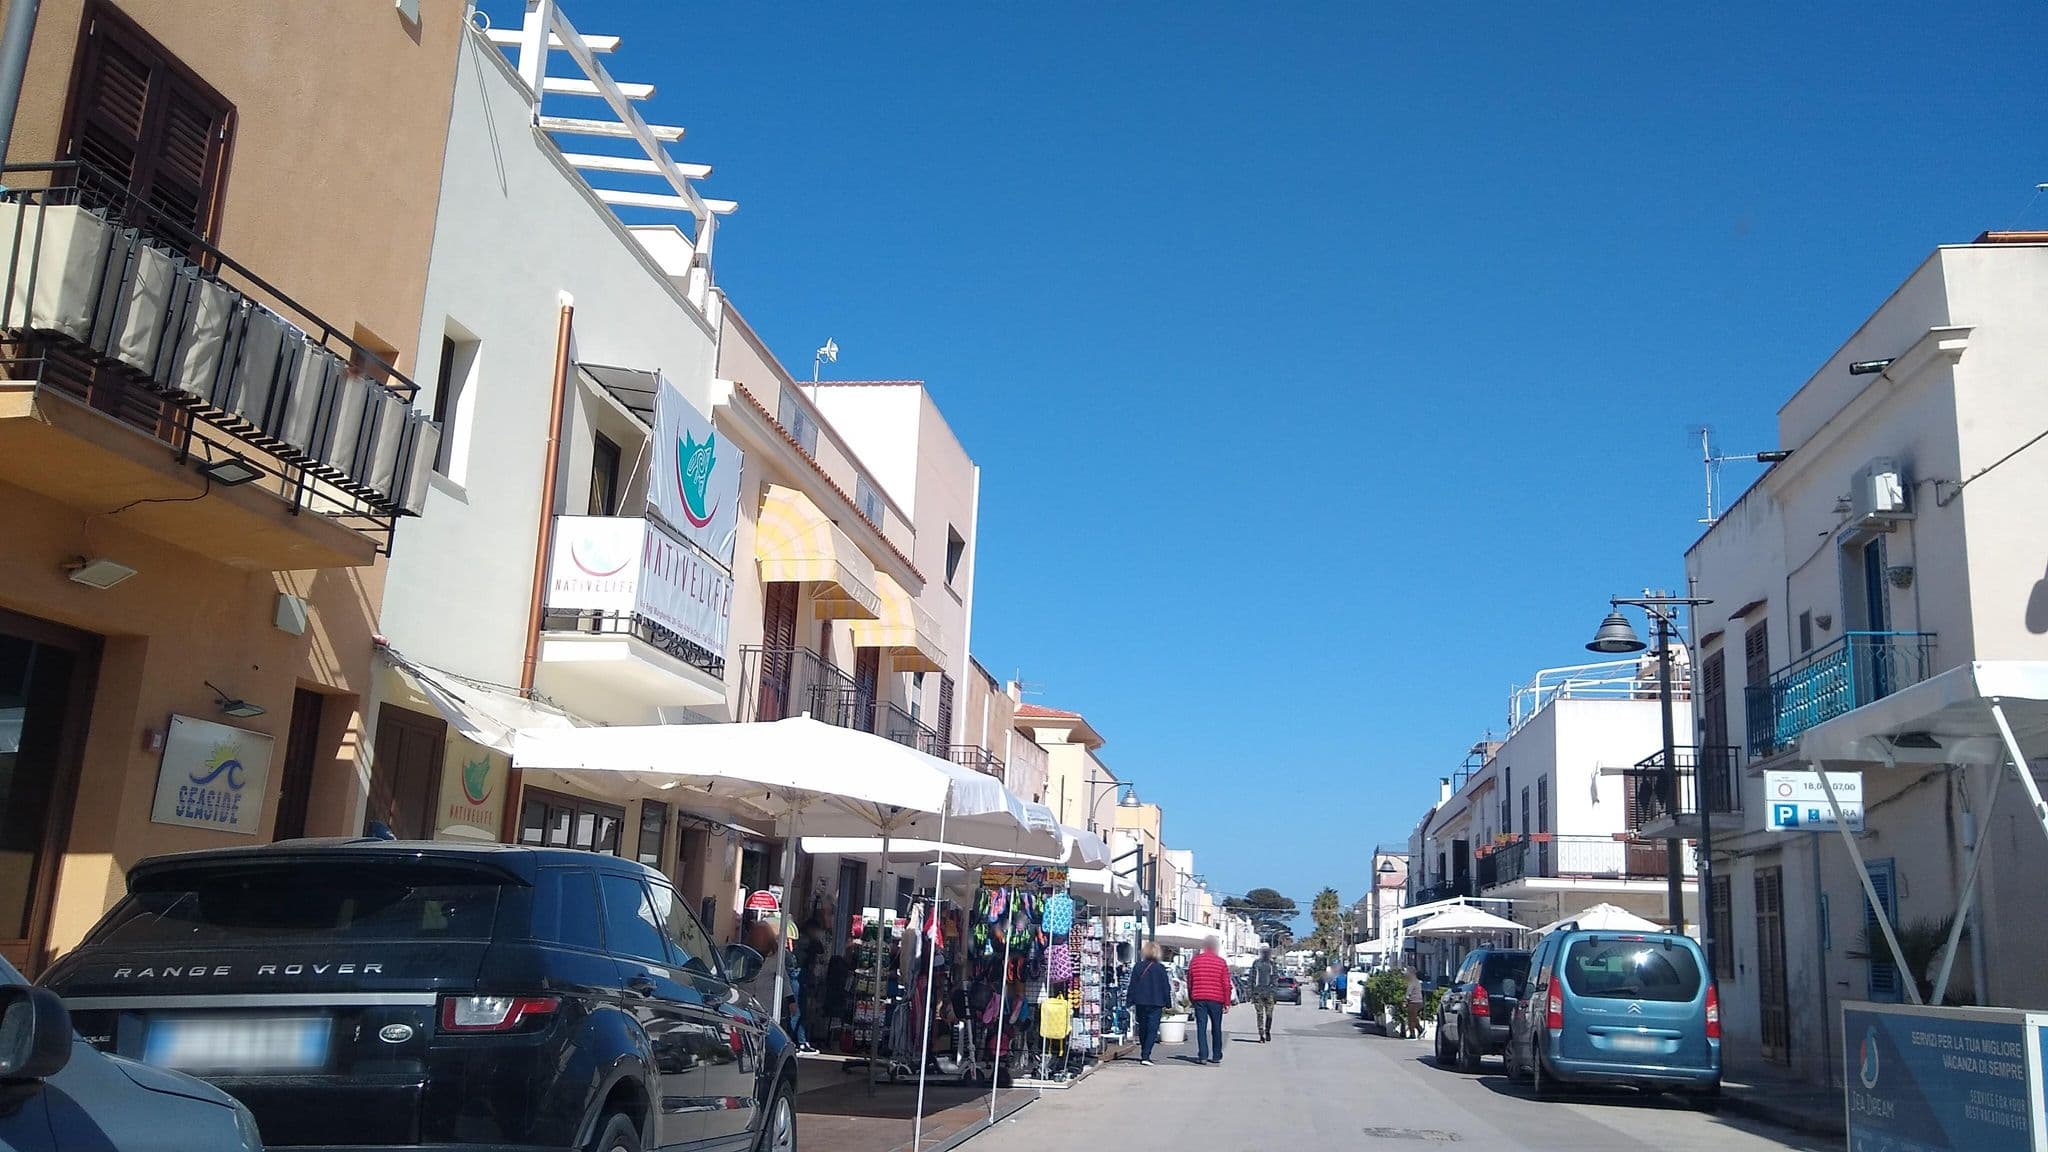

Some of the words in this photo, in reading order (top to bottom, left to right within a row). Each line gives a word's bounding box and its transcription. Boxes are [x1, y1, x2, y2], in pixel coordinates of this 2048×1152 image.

[643, 530, 730, 618] NATIVELIFE
[555, 578, 633, 593] NATIVELIFE
[1780, 806, 1793, 825] P
[113, 965, 232, 979] RANGE
[257, 963, 384, 976] ROVER
[1911, 1031, 1937, 1047] SERVIZI
[1938, 1034, 1953, 1049] PER
[1954, 1036, 1964, 1051] LA
[1964, 1037, 1981, 1053] TUA
[1982, 1039, 2022, 1058] MIGLIORE
[1942, 1054, 1978, 1073] VACANZA
[1988, 1060, 2024, 1080] SEMPRE
